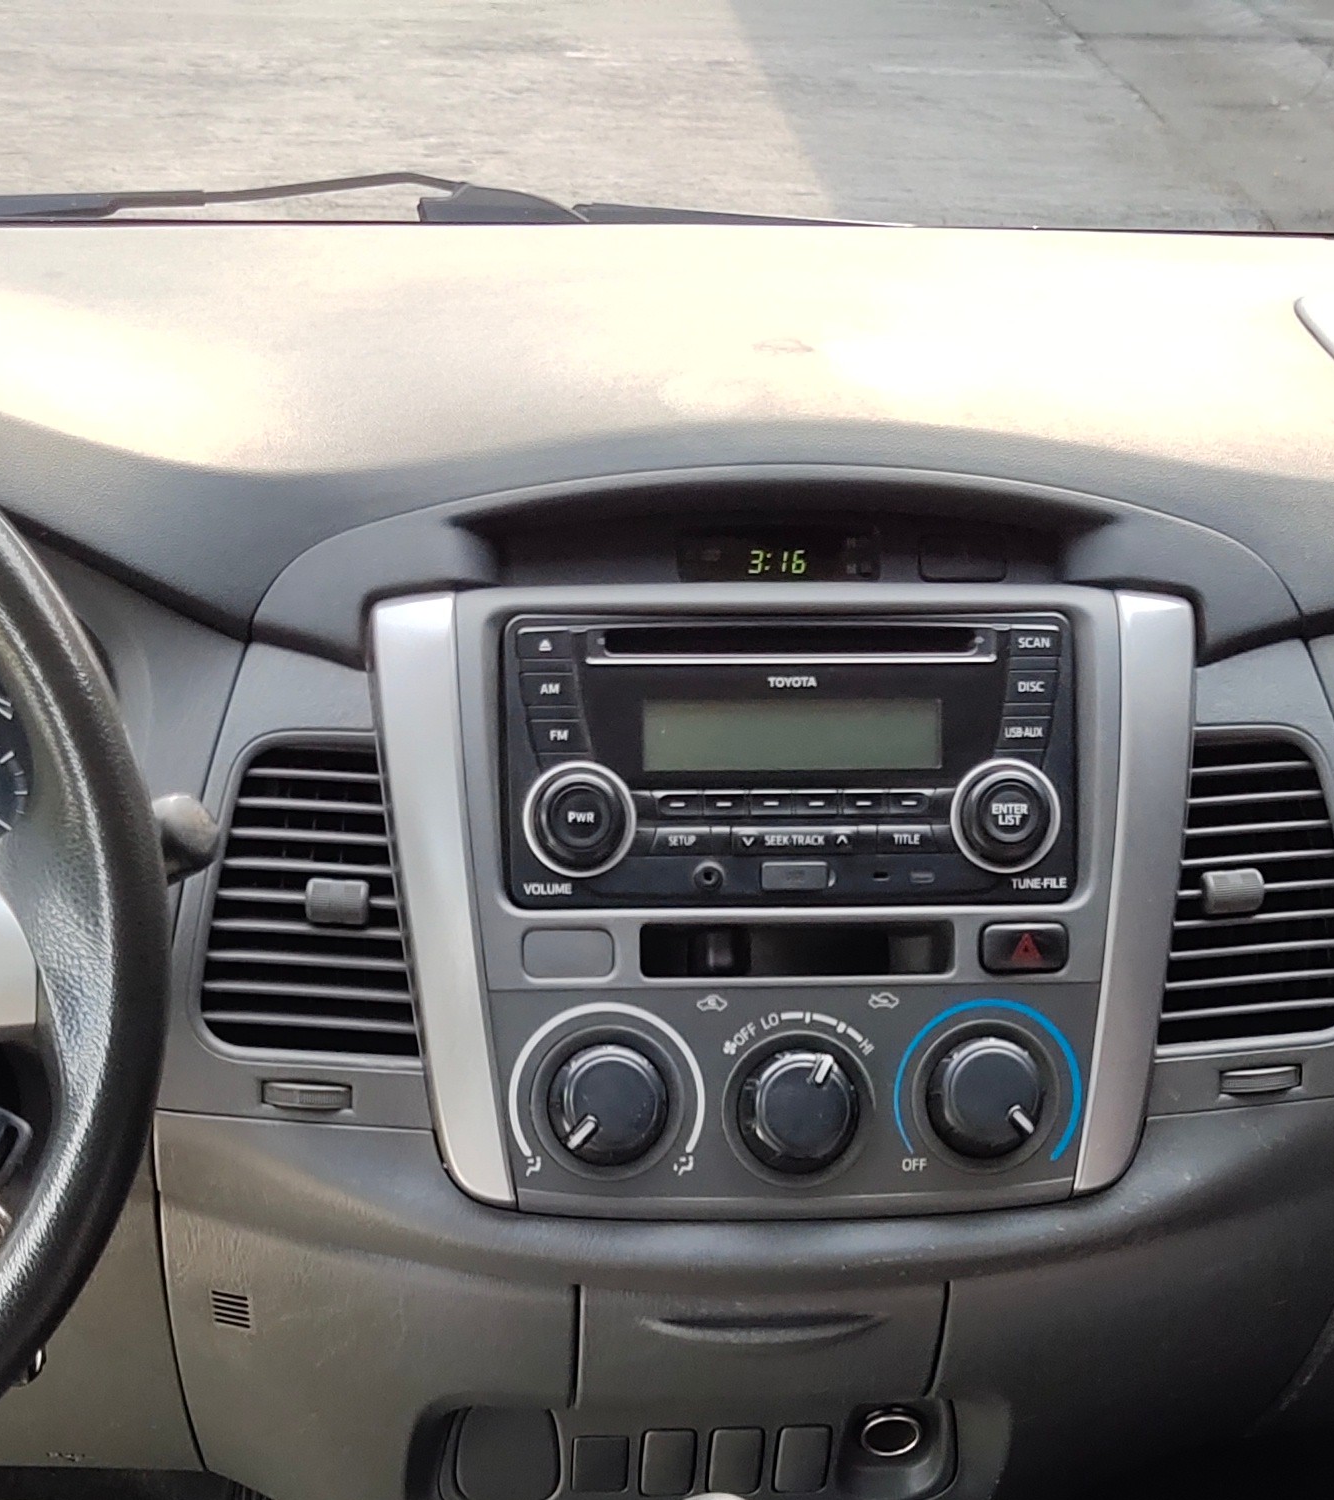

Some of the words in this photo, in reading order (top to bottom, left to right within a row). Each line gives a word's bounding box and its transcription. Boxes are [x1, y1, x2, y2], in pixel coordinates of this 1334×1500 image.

[748, 550, 806, 574] 3:16
[1017, 637, 1051, 648] SCAN
[767, 676, 817, 688] TOYOTA
[1017, 681, 1045, 693] DISC
[540, 683, 560, 695] AM
[549, 729, 569, 741] FM
[991, 803, 1028, 815] ENTER
[567, 811, 595, 823] PWR
[998, 814, 1022, 826] LIST
[668, 835, 697, 846] SETUP
[893, 833, 921, 845] TITLE
[523, 883, 572, 895] VOLUME
[733, 1021, 757, 1047] OFF
[760, 1012, 779, 1030] LO
[858, 1037, 875, 1056] HI
[902, 1158, 927, 1171] OFF
